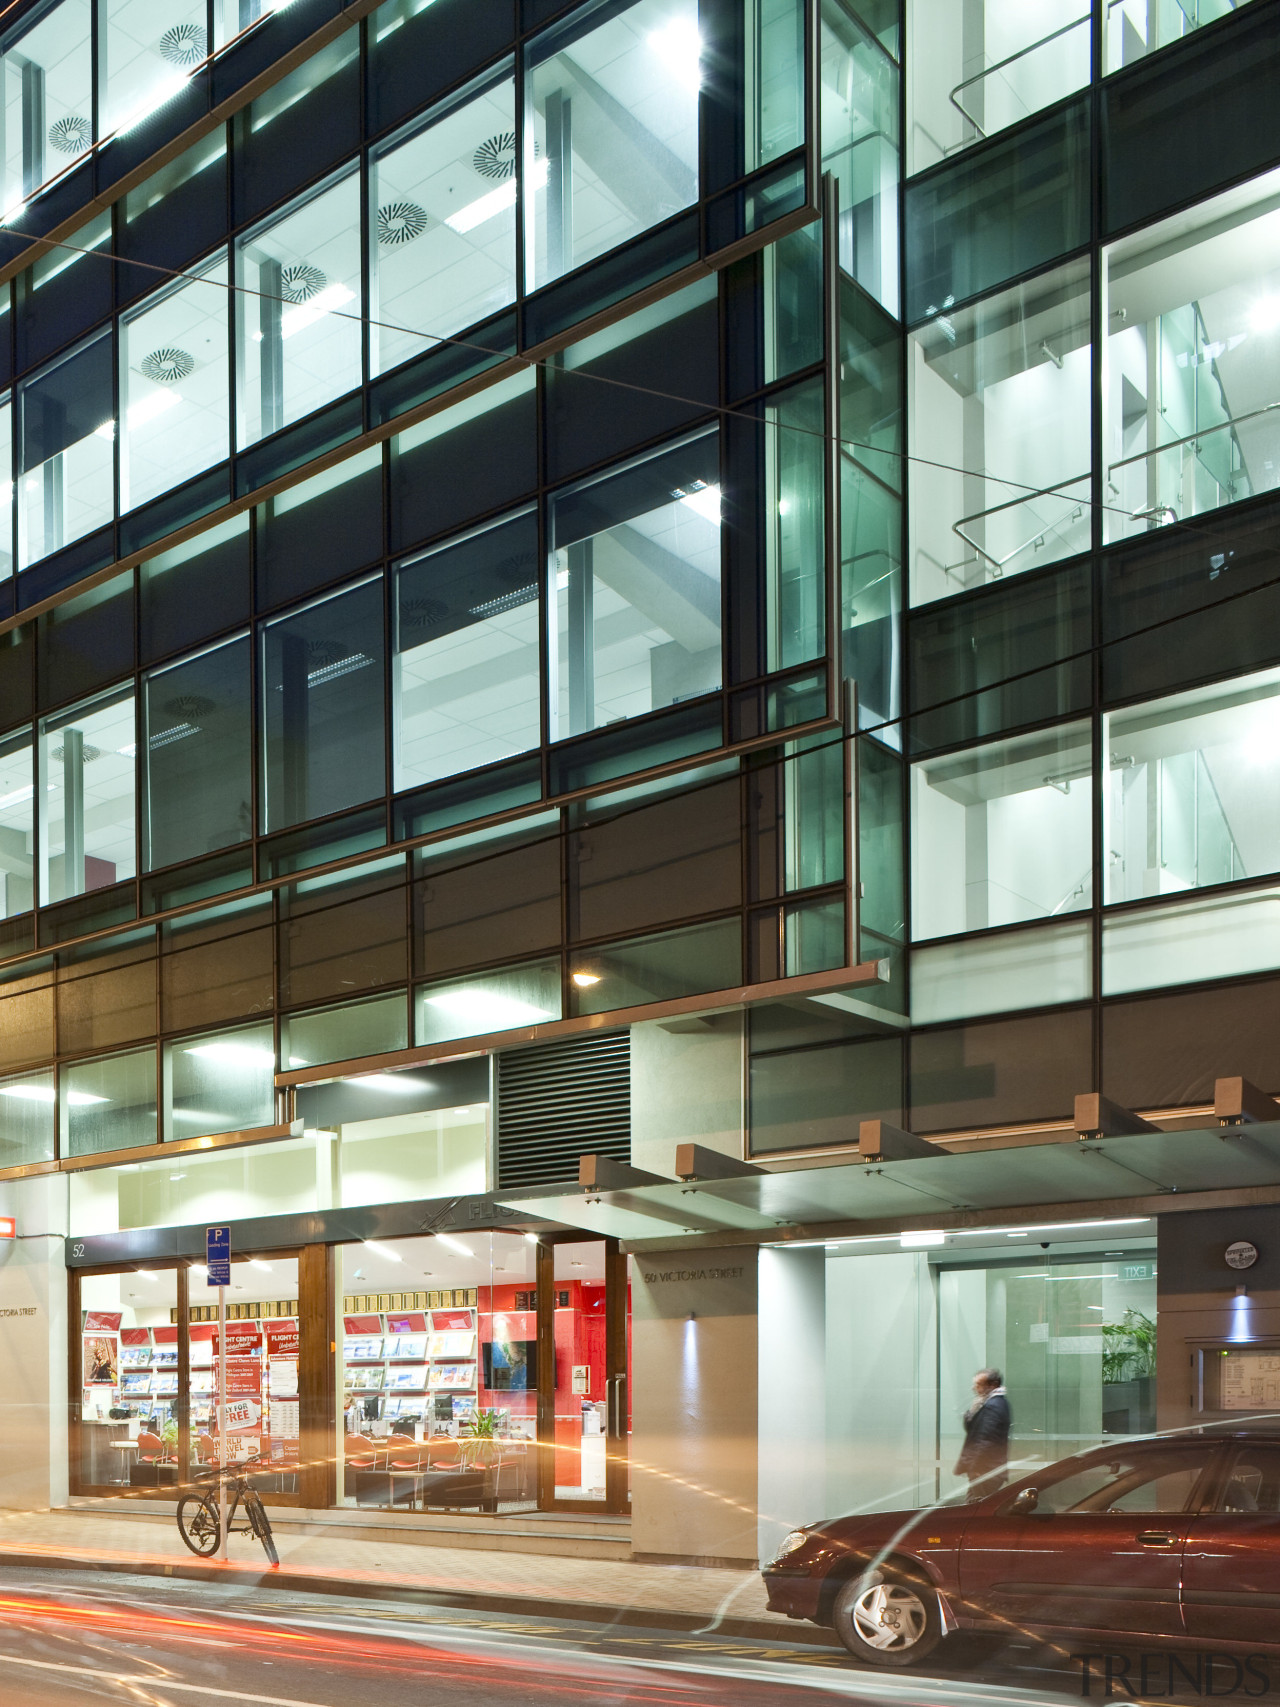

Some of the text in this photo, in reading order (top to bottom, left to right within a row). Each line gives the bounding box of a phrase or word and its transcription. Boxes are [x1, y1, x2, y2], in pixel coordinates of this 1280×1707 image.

[215, 1230, 222, 1241] P
[73, 1244, 85, 1257] 52
[644, 1267, 744, 1283] 50 VICTORIA STREET
[19, 1307, 37, 1316] STREET
[234, 1403, 248, 1411] FOR
[214, 1438, 241, 1447] WRLD
[214, 1444, 244, 1454] TAVEL
[214, 1452, 236, 1460] SOW
